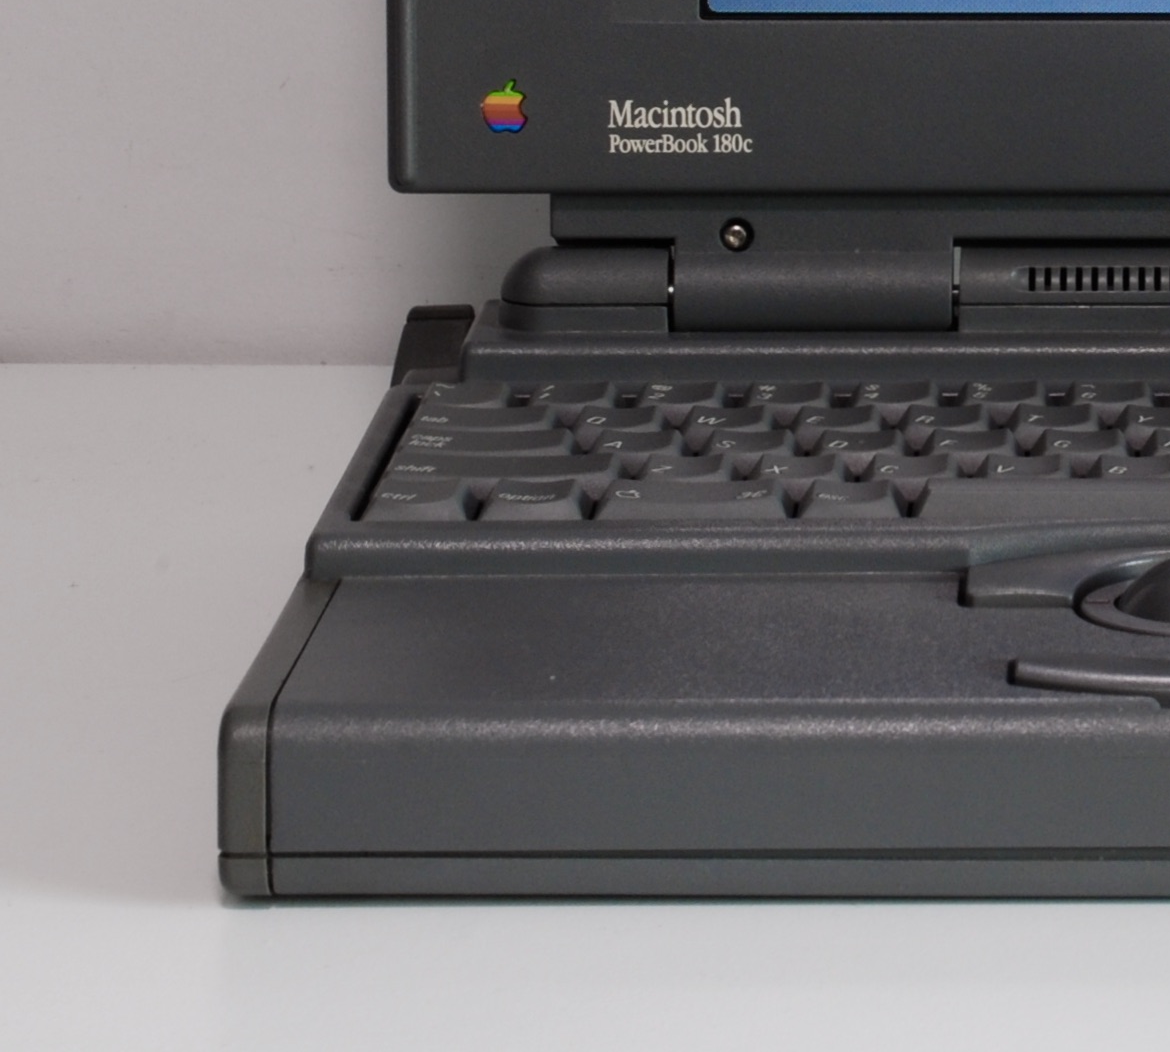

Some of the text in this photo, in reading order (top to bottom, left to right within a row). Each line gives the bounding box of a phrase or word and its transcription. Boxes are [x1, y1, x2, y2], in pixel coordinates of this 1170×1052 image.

[608, 97, 742, 128] Macintosh
[609, 133, 753, 153] PowerBook 180c
